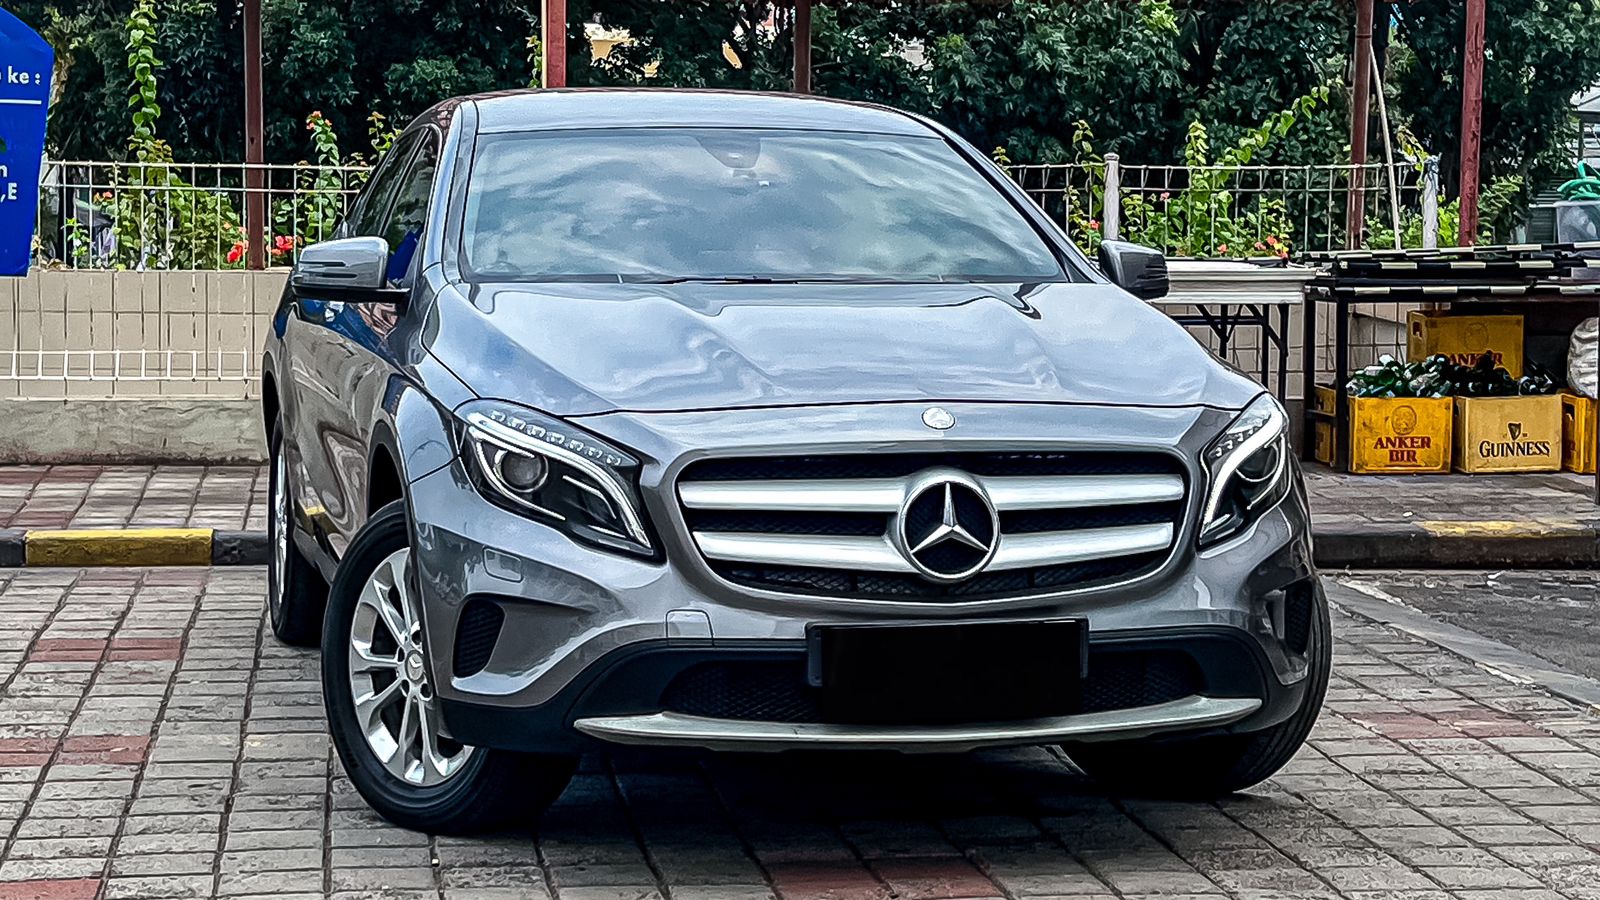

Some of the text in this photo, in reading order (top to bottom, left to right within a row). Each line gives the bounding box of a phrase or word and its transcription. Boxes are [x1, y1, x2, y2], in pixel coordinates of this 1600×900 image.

[1373, 436, 1431, 449] ANKER
[1479, 440, 1551, 458] GUINNESS
[1389, 449, 1417, 463] BIR
